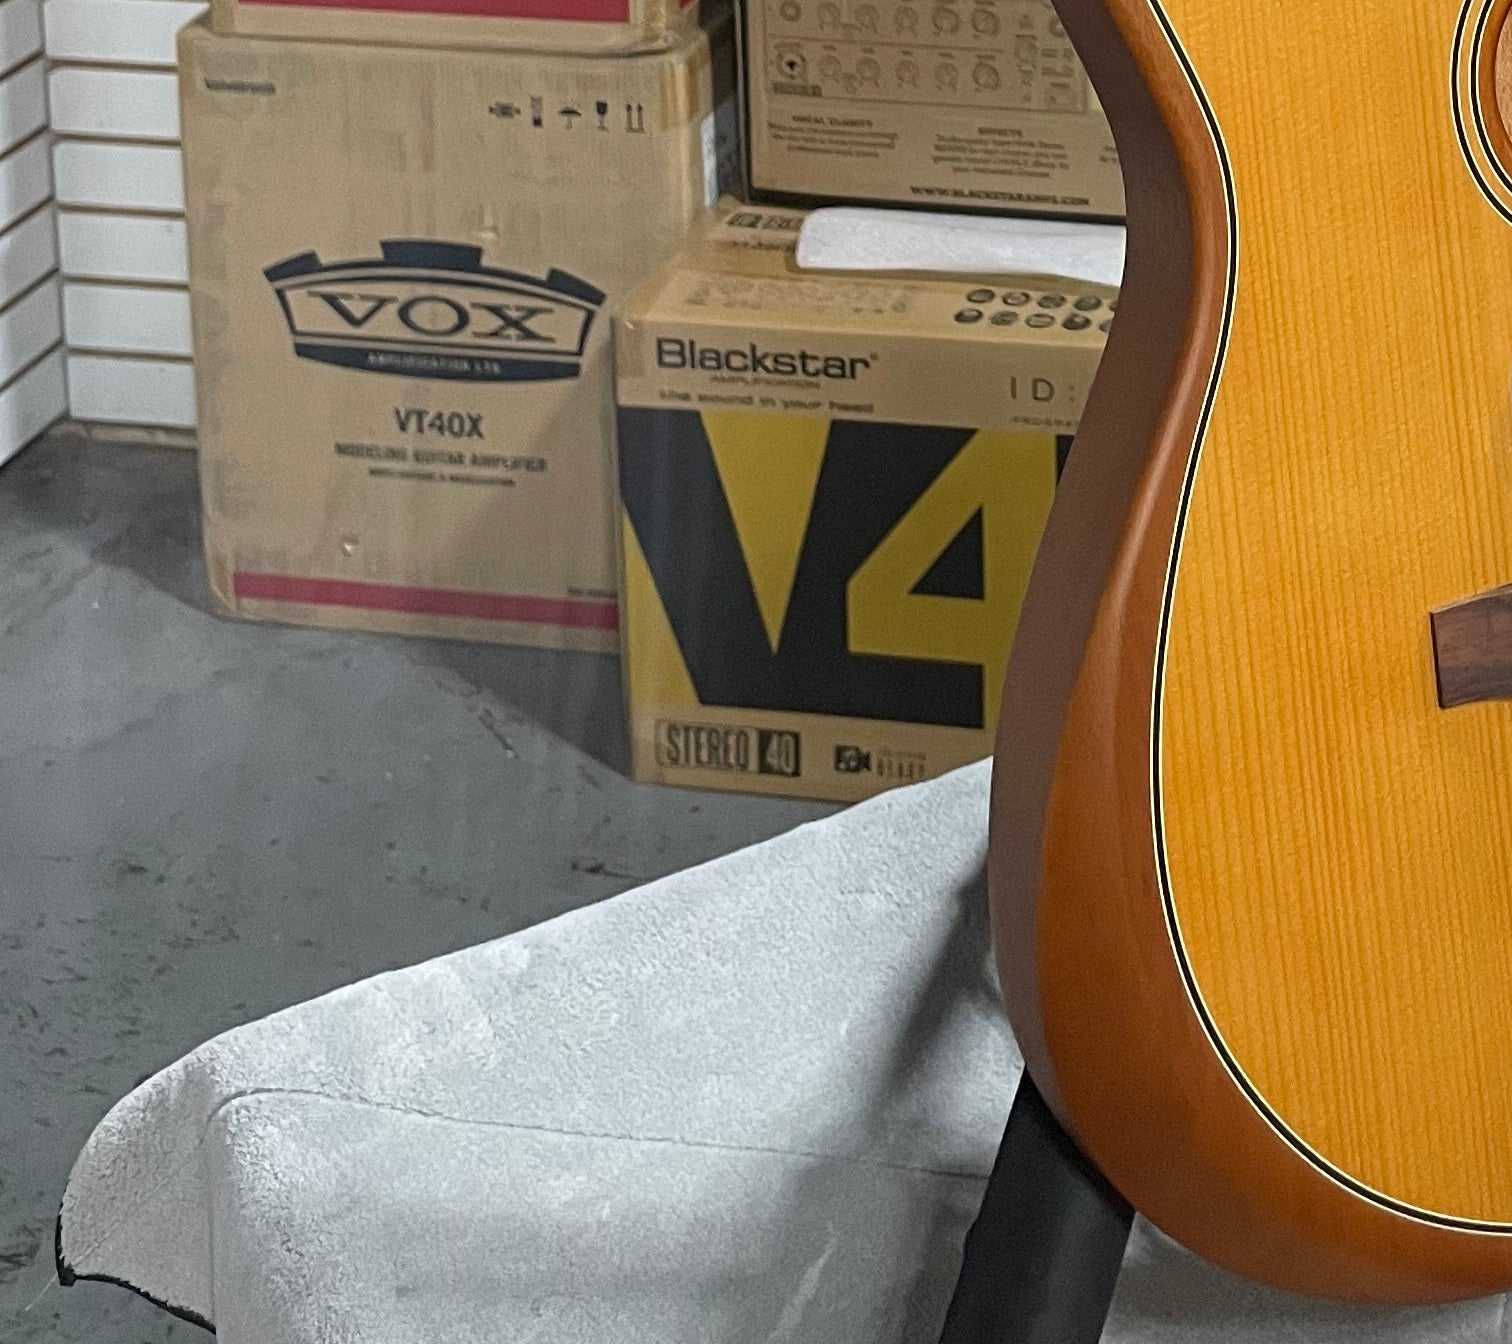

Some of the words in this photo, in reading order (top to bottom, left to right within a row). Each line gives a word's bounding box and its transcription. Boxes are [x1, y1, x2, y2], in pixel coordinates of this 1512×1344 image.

[308, 290, 556, 344] VOX
[656, 336, 871, 380] Blackstar
[394, 406, 486, 440] VT40X
[665, 723, 748, 772] STEREO
[764, 732, 796, 775] 40
